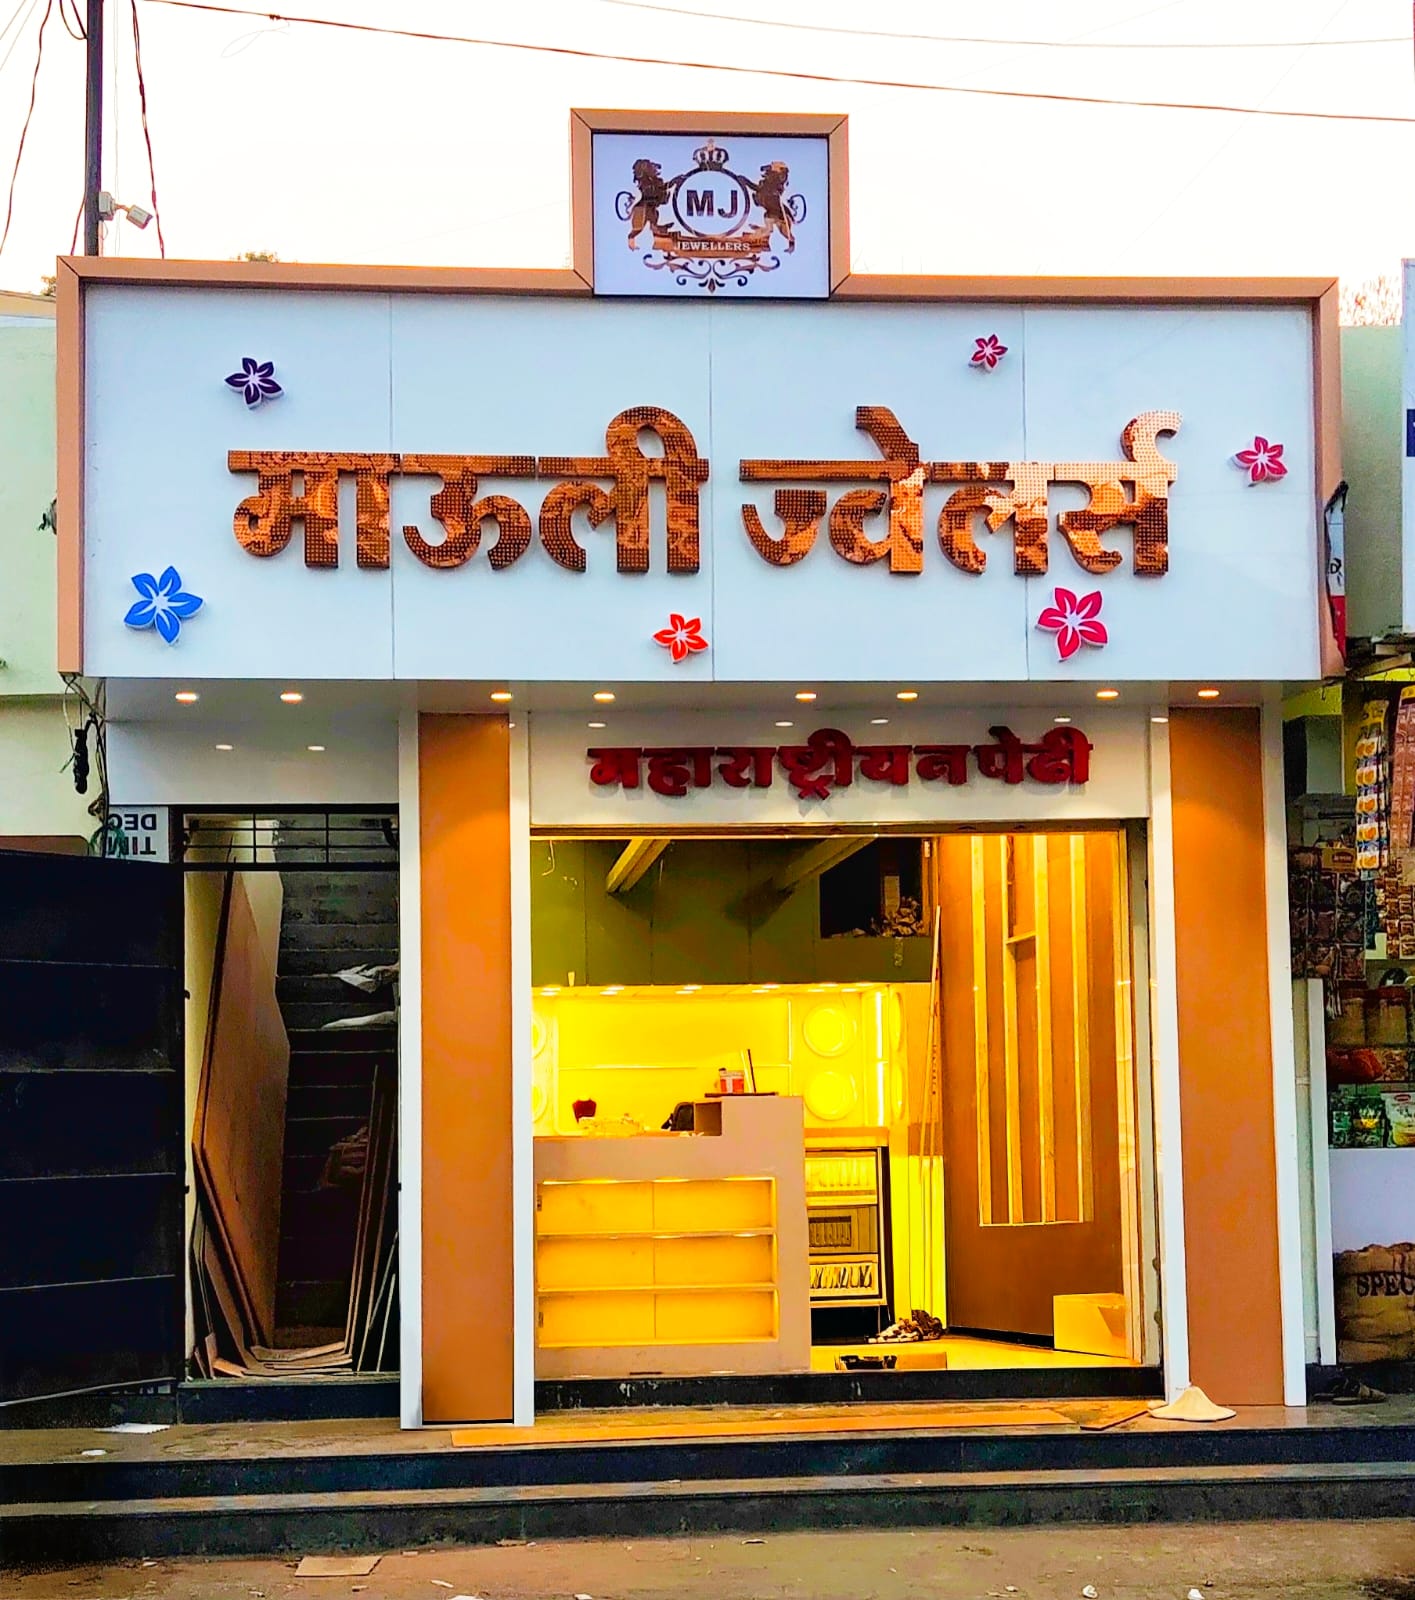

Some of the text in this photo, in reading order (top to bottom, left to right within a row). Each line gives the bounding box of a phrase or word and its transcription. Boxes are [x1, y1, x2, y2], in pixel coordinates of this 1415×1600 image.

[685, 189, 738, 218] MJ
[673, 239, 751, 251] JEWELLERS
[228, 405, 1183, 577] माऊली ज्वेलर्स
